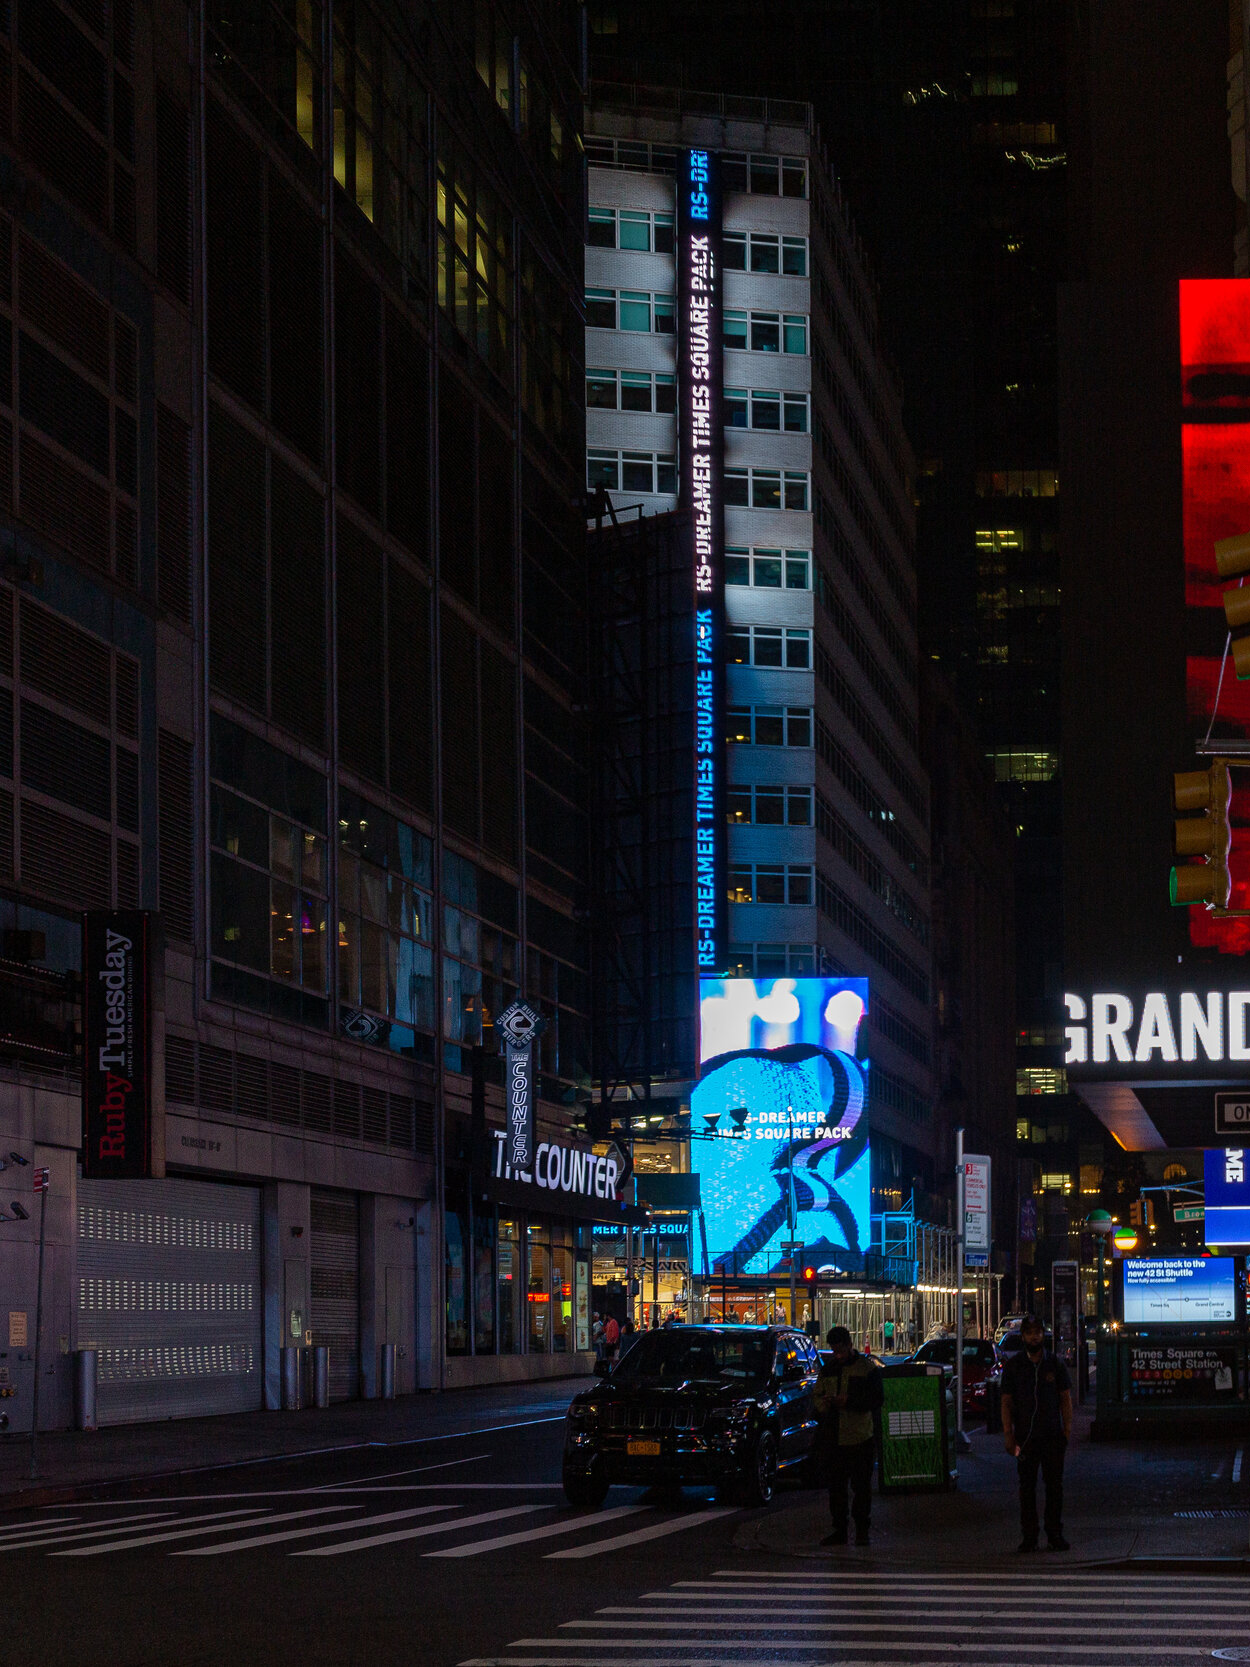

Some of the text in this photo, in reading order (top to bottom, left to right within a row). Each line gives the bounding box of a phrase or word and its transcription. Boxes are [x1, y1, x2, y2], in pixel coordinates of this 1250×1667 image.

[690, 150, 709, 220] RS-DR
[690, 235, 712, 592] RS-DREAMER TIMES SQUARE PACK
[696, 608, 716, 966] RS-DREAMER TIMES SQUARE PACK
[496, 1001, 541, 1026] CUSTOM BUILT
[98, 928, 134, 1160] Ruby Tuesday
[502, 1029, 536, 1048] BURGERS
[511, 1053, 529, 1062] THE
[511, 1062, 528, 1164] COUNTER
[743, 1111, 827, 1124] S-DREAMER
[755, 1127, 811, 1140] SQUARE
[814, 1126, 852, 1140] PACK
[535, 1143, 618, 1200] COUNTER
[1225, 1147, 1244, 1183] ME
[1127, 1259, 1206, 1269] Welcome back to the
[1127, 1268, 1194, 1278] new 42 St Shuttle
[1131, 1349, 1163, 1359] Times
[1167, 1348, 1204, 1360] Square
[1131, 1358, 1223, 1370] 42 Street Station
